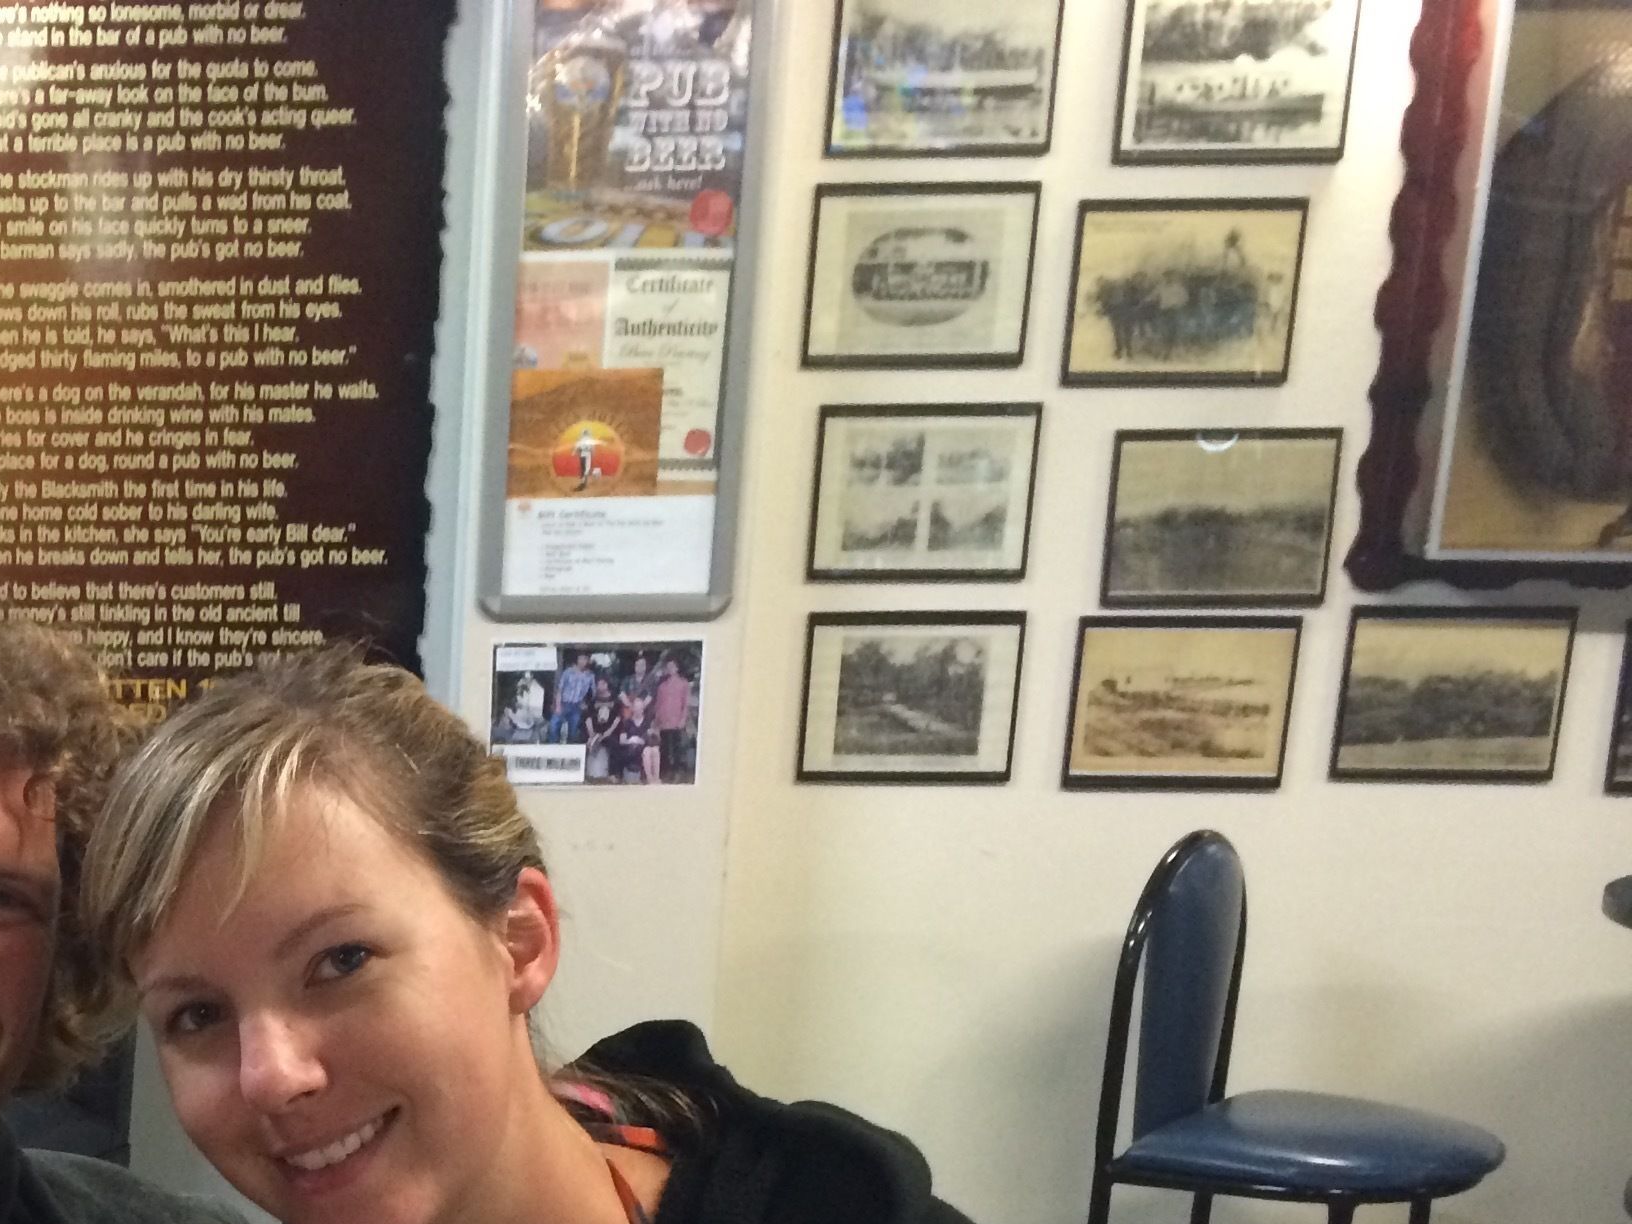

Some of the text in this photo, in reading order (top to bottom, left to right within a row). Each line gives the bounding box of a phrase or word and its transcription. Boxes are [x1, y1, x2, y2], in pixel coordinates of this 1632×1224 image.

[623, 60, 730, 107] PUB
[627, 108, 729, 133] WITH NO
[624, 135, 726, 172] BEER
[625, 274, 715, 295] Certificate
[27, 303, 67, 321] down
[70, 303, 91, 320] his
[126, 302, 158, 320] rubs
[163, 302, 187, 319] the
[192, 301, 235, 319] sweat
[241, 301, 275, 318] from
[278, 300, 300, 318] his
[615, 317, 719, 339] Authenticity
[14, 481, 37, 498] the
[41, 480, 118, 498] Blacksmith
[123, 480, 146, 498] the
[151, 480, 179, 498] first
[184, 480, 216, 497] time
[220, 480, 233, 497] in
[237, 480, 258, 497] his
[19, 525, 32, 542] in
[37, 525, 60, 542] the
[123, 525, 149, 542] she
[153, 528, 186, 547] says
[246, 525, 281, 547] early
[285, 525, 308, 542] Bill
[136, 652, 168, 666] care
[172, 649, 181, 666] if
[187, 649, 210, 666] the
[214, 649, 253, 671] pub's
